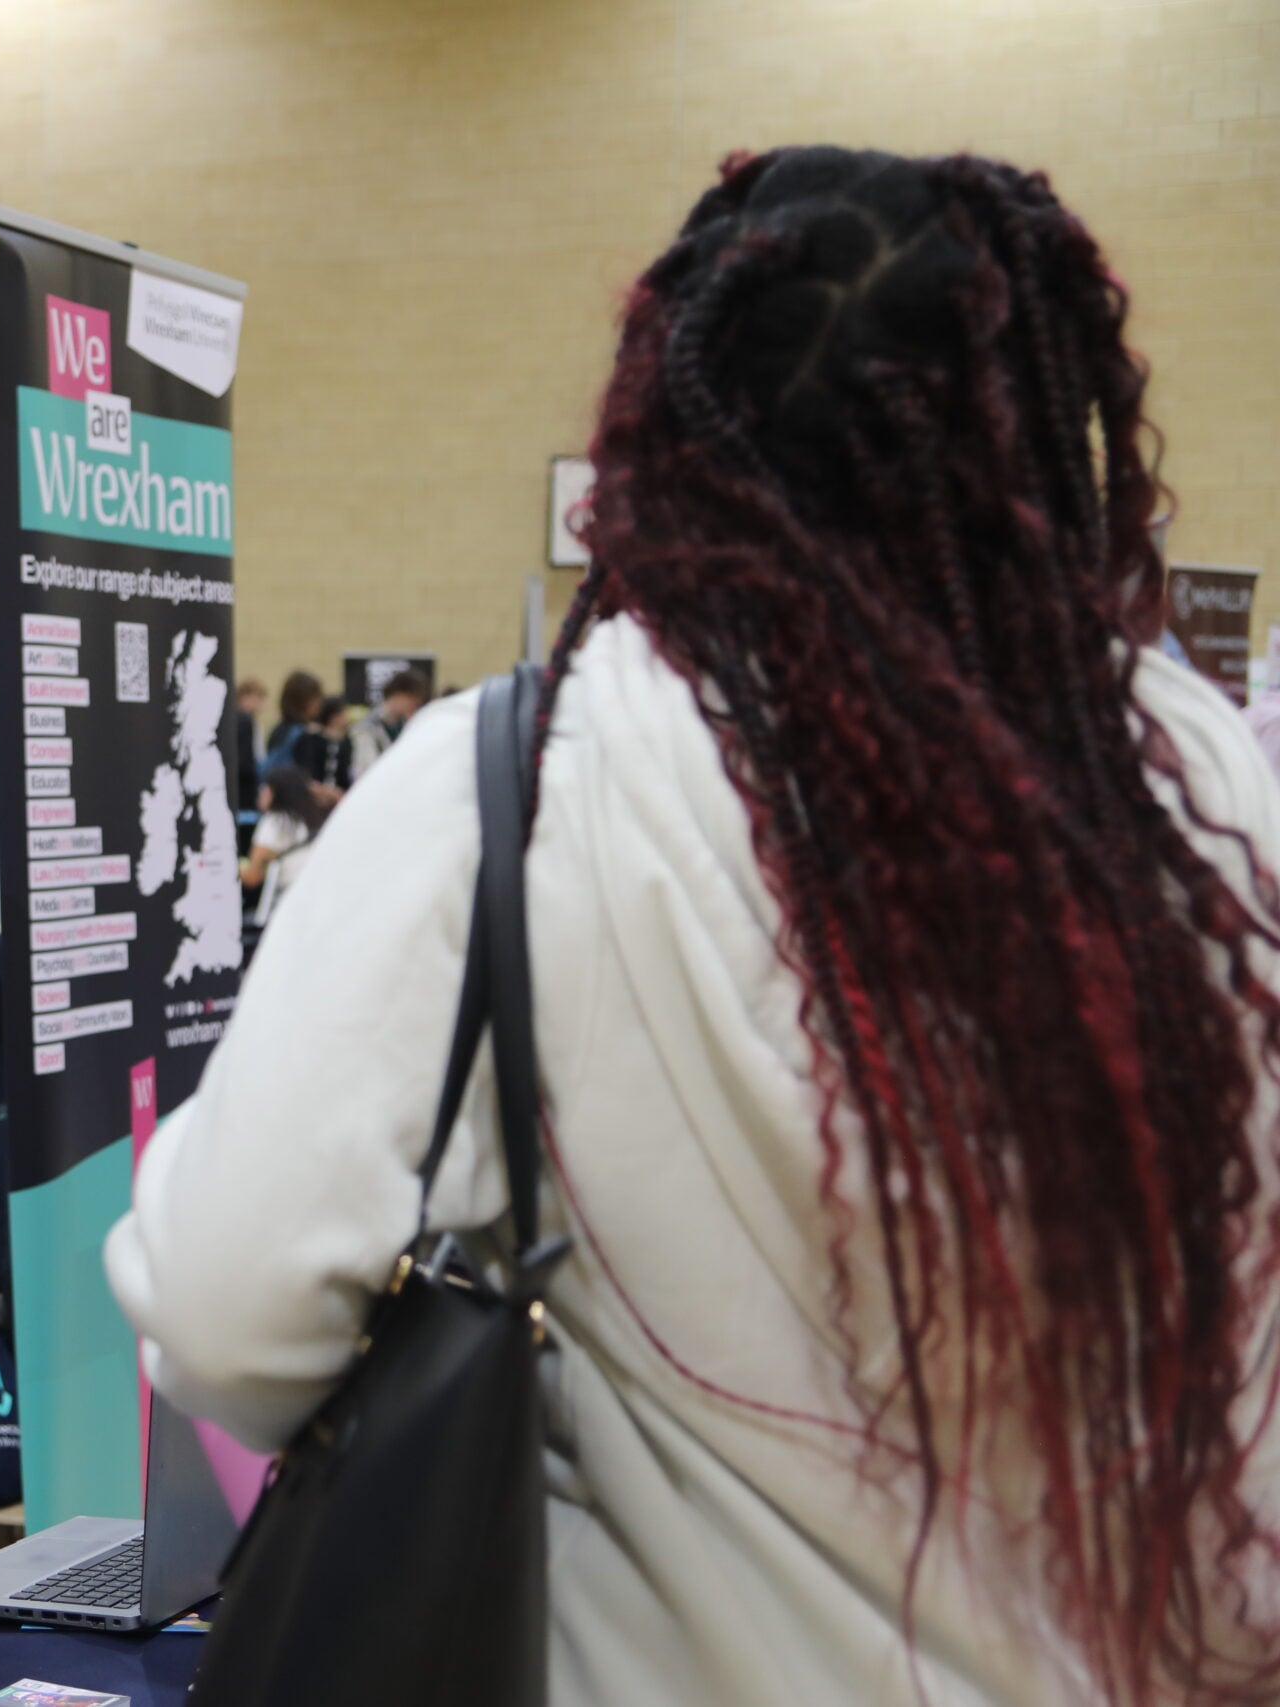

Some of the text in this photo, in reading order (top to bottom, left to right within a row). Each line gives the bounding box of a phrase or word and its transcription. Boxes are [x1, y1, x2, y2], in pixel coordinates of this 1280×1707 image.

[50, 307, 106, 385] We
[91, 402, 128, 443] are
[30, 427, 231, 541] Wrexham
[20, 553, 74, 591] Explore
[75, 565, 97, 591] our
[97, 568, 136, 602] range
[137, 567, 151, 597] of
[151, 569, 202, 606] subject
